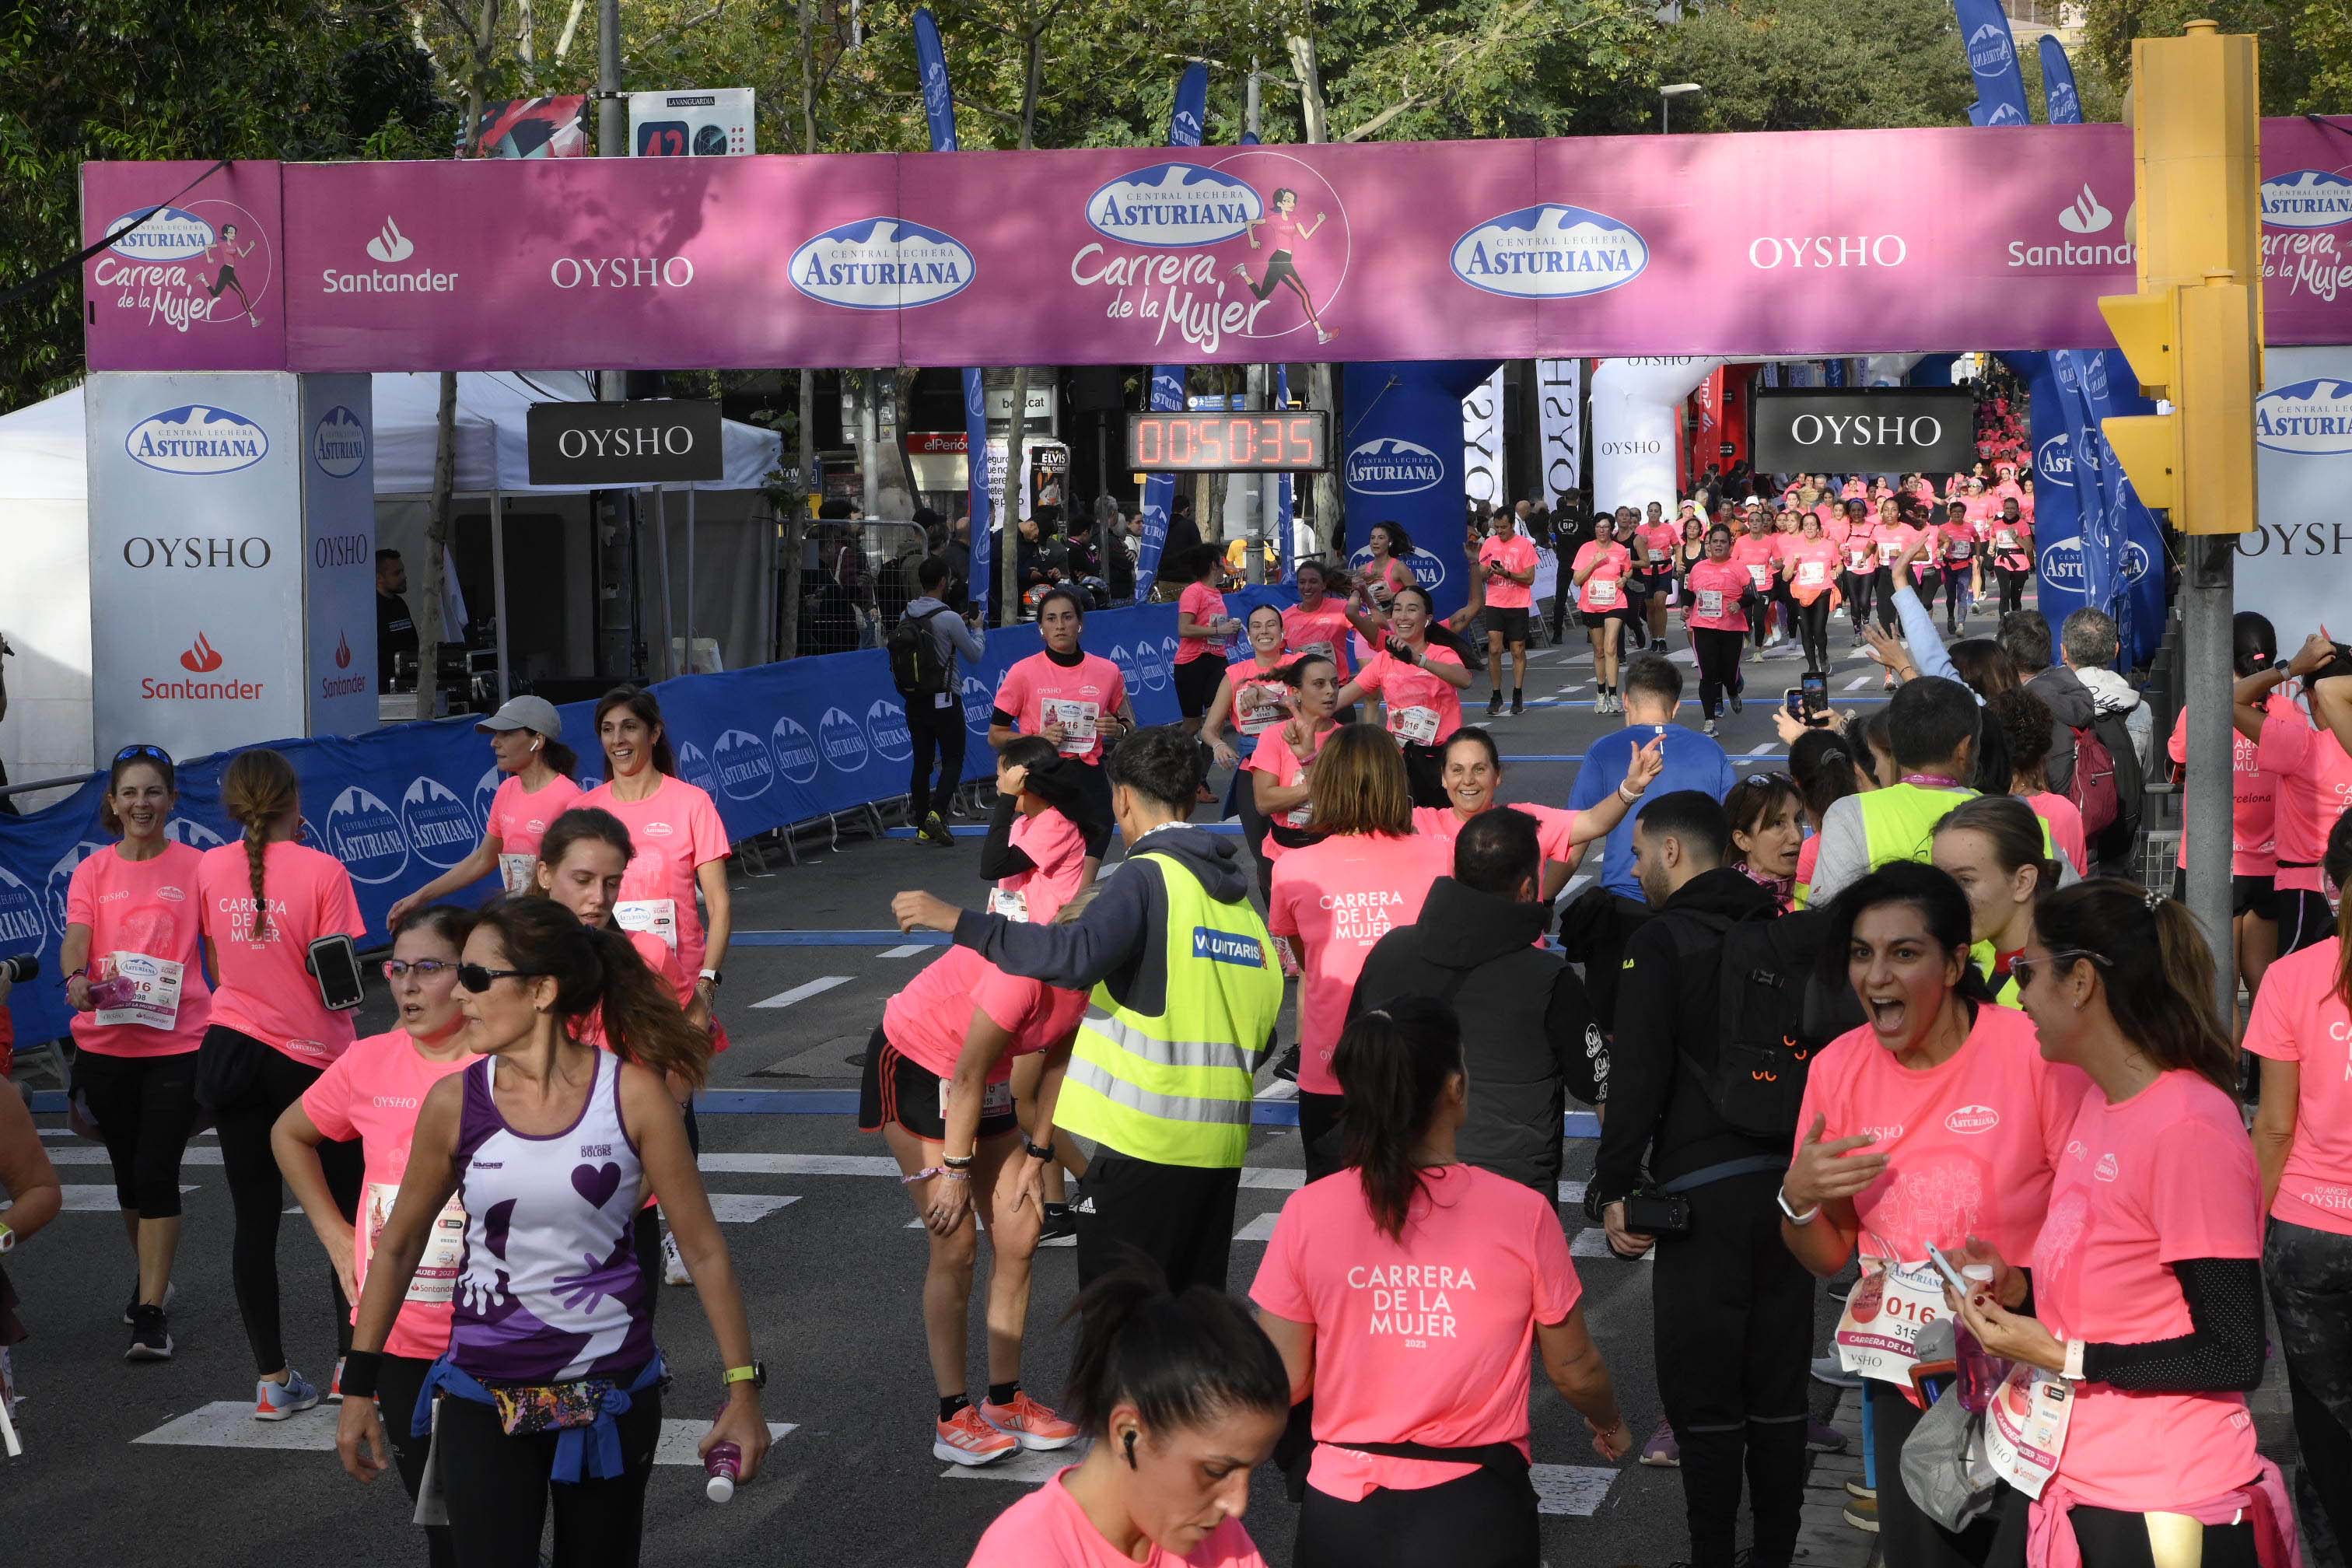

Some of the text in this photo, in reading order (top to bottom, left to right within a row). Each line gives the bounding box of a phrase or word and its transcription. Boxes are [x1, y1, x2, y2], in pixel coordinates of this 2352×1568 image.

[1126, 190, 1244, 201] CENTRAL LECHERA
[1100, 194, 1251, 226] ASTURIANA
[114, 226, 207, 247] ASTURIANA
[1496, 236, 1627, 247] CENTRAL LECHERA
[2261, 233, 2336, 256] arrera
[831, 249, 955, 259] CENTRAL LECHERA
[1465, 240, 1634, 275] ASTURIANA
[1748, 234, 1907, 269] OYSHO
[94, 257, 187, 287] Carrera
[551, 256, 695, 289] OYSHO
[803, 252, 962, 286] ASTURIANA
[1071, 243, 1218, 287] Carrera
[2279, 256, 2294, 278] la
[323, 268, 459, 293] Santander
[117, 284, 222, 333] de la Mujer
[1107, 281, 1272, 354] de la Mujer
[2277, 404, 2330, 414] CENTRAL
[208, 429, 254, 437] LECHERA
[1791, 414, 1942, 447] OYSHO
[2256, 407, 2352, 436] ASTURI
[137, 430, 259, 458] ASTURIANA
[317, 435, 363, 460] ASTURIANA
[558, 425, 694, 459] OYSHO
[1139, 419, 1313, 464] 00:50:35
[1601, 439, 1661, 456] OYSHO
[1041, 453, 1066, 464] ELVIS
[1348, 460, 1437, 483] ASTURIANA
[1562, 520, 1574, 530] BP
[123, 536, 271, 569] OYSHO
[314, 534, 368, 569] OYSHO
[142, 677, 264, 700] Santander
[322, 671, 366, 699] Santander
[1405, 720, 1419, 730] 016
[777, 746, 816, 769] ASTURIANA
[2236, 749, 2252, 761] DE
[2233, 791, 2272, 804] rcelona
[408, 813, 475, 849] ASTURIANA
[333, 825, 405, 863] ASTURIANA
[1319, 891, 1404, 911] CARRERA
[232, 913, 252, 928] DE
[1337, 906, 1389, 924] DE LA
[134, 982, 151, 992] 16
[373, 1095, 418, 1109] OYSHO
[1950, 1116, 1996, 1129] ASTURIANA
[581, 1149, 612, 1157] DOLORS
[1347, 1265, 1477, 1291] CARRERA
[1373, 1290, 1452, 1313] DE LA
[1886, 1297, 1937, 1325] 016
[1369, 1314, 1457, 1339] MUJER
[1405, 1339, 1427, 1349] 2023
[1849, 1335, 1912, 1355] CARRERA DE LA
